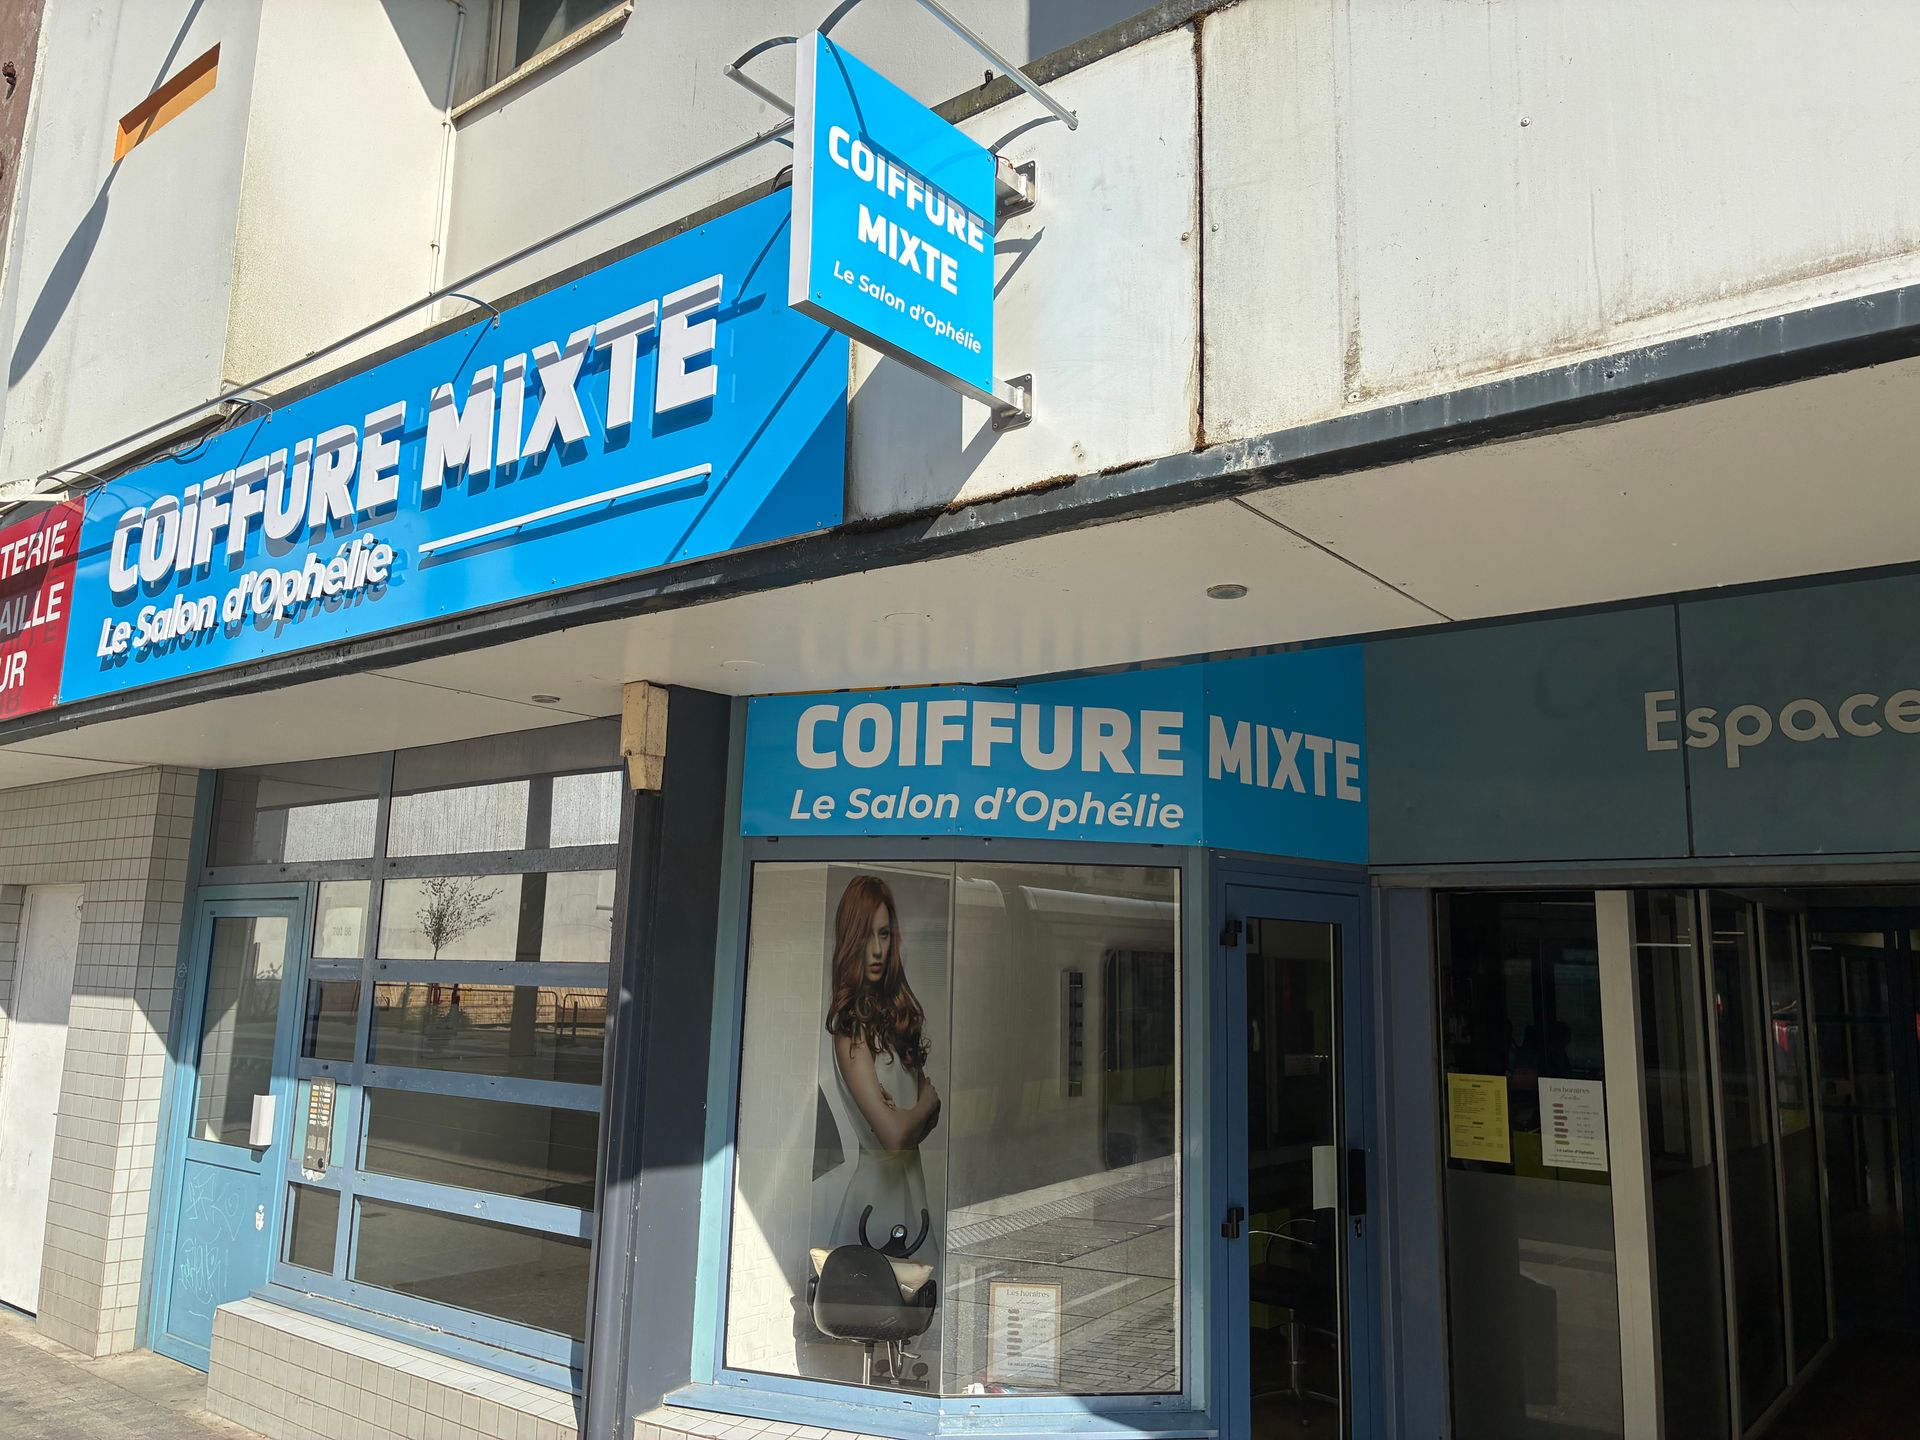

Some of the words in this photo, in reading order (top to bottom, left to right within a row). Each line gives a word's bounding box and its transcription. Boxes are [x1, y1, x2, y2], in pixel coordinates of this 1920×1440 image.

[828, 125, 985, 254] COIFFURE
[857, 203, 958, 296] MIXTE
[833, 261, 855, 285] Le
[858, 273, 906, 313] Salon
[909, 305, 982, 355] d'Ophélie
[108, 400, 407, 594] COIFFURE
[421, 273, 723, 492] MIXTE
[97, 617, 131, 657] Le
[133, 594, 217, 648] Salon
[222, 532, 398, 621] d'Ophélie
[796, 699, 1184, 776] COIFFURE
[1208, 715, 1362, 802] MIXTE
[1644, 688, 1920, 768] Espace
[790, 789, 834, 820] Le
[845, 786, 960, 820] Salon
[974, 787, 1184, 831] d'Ophélie
